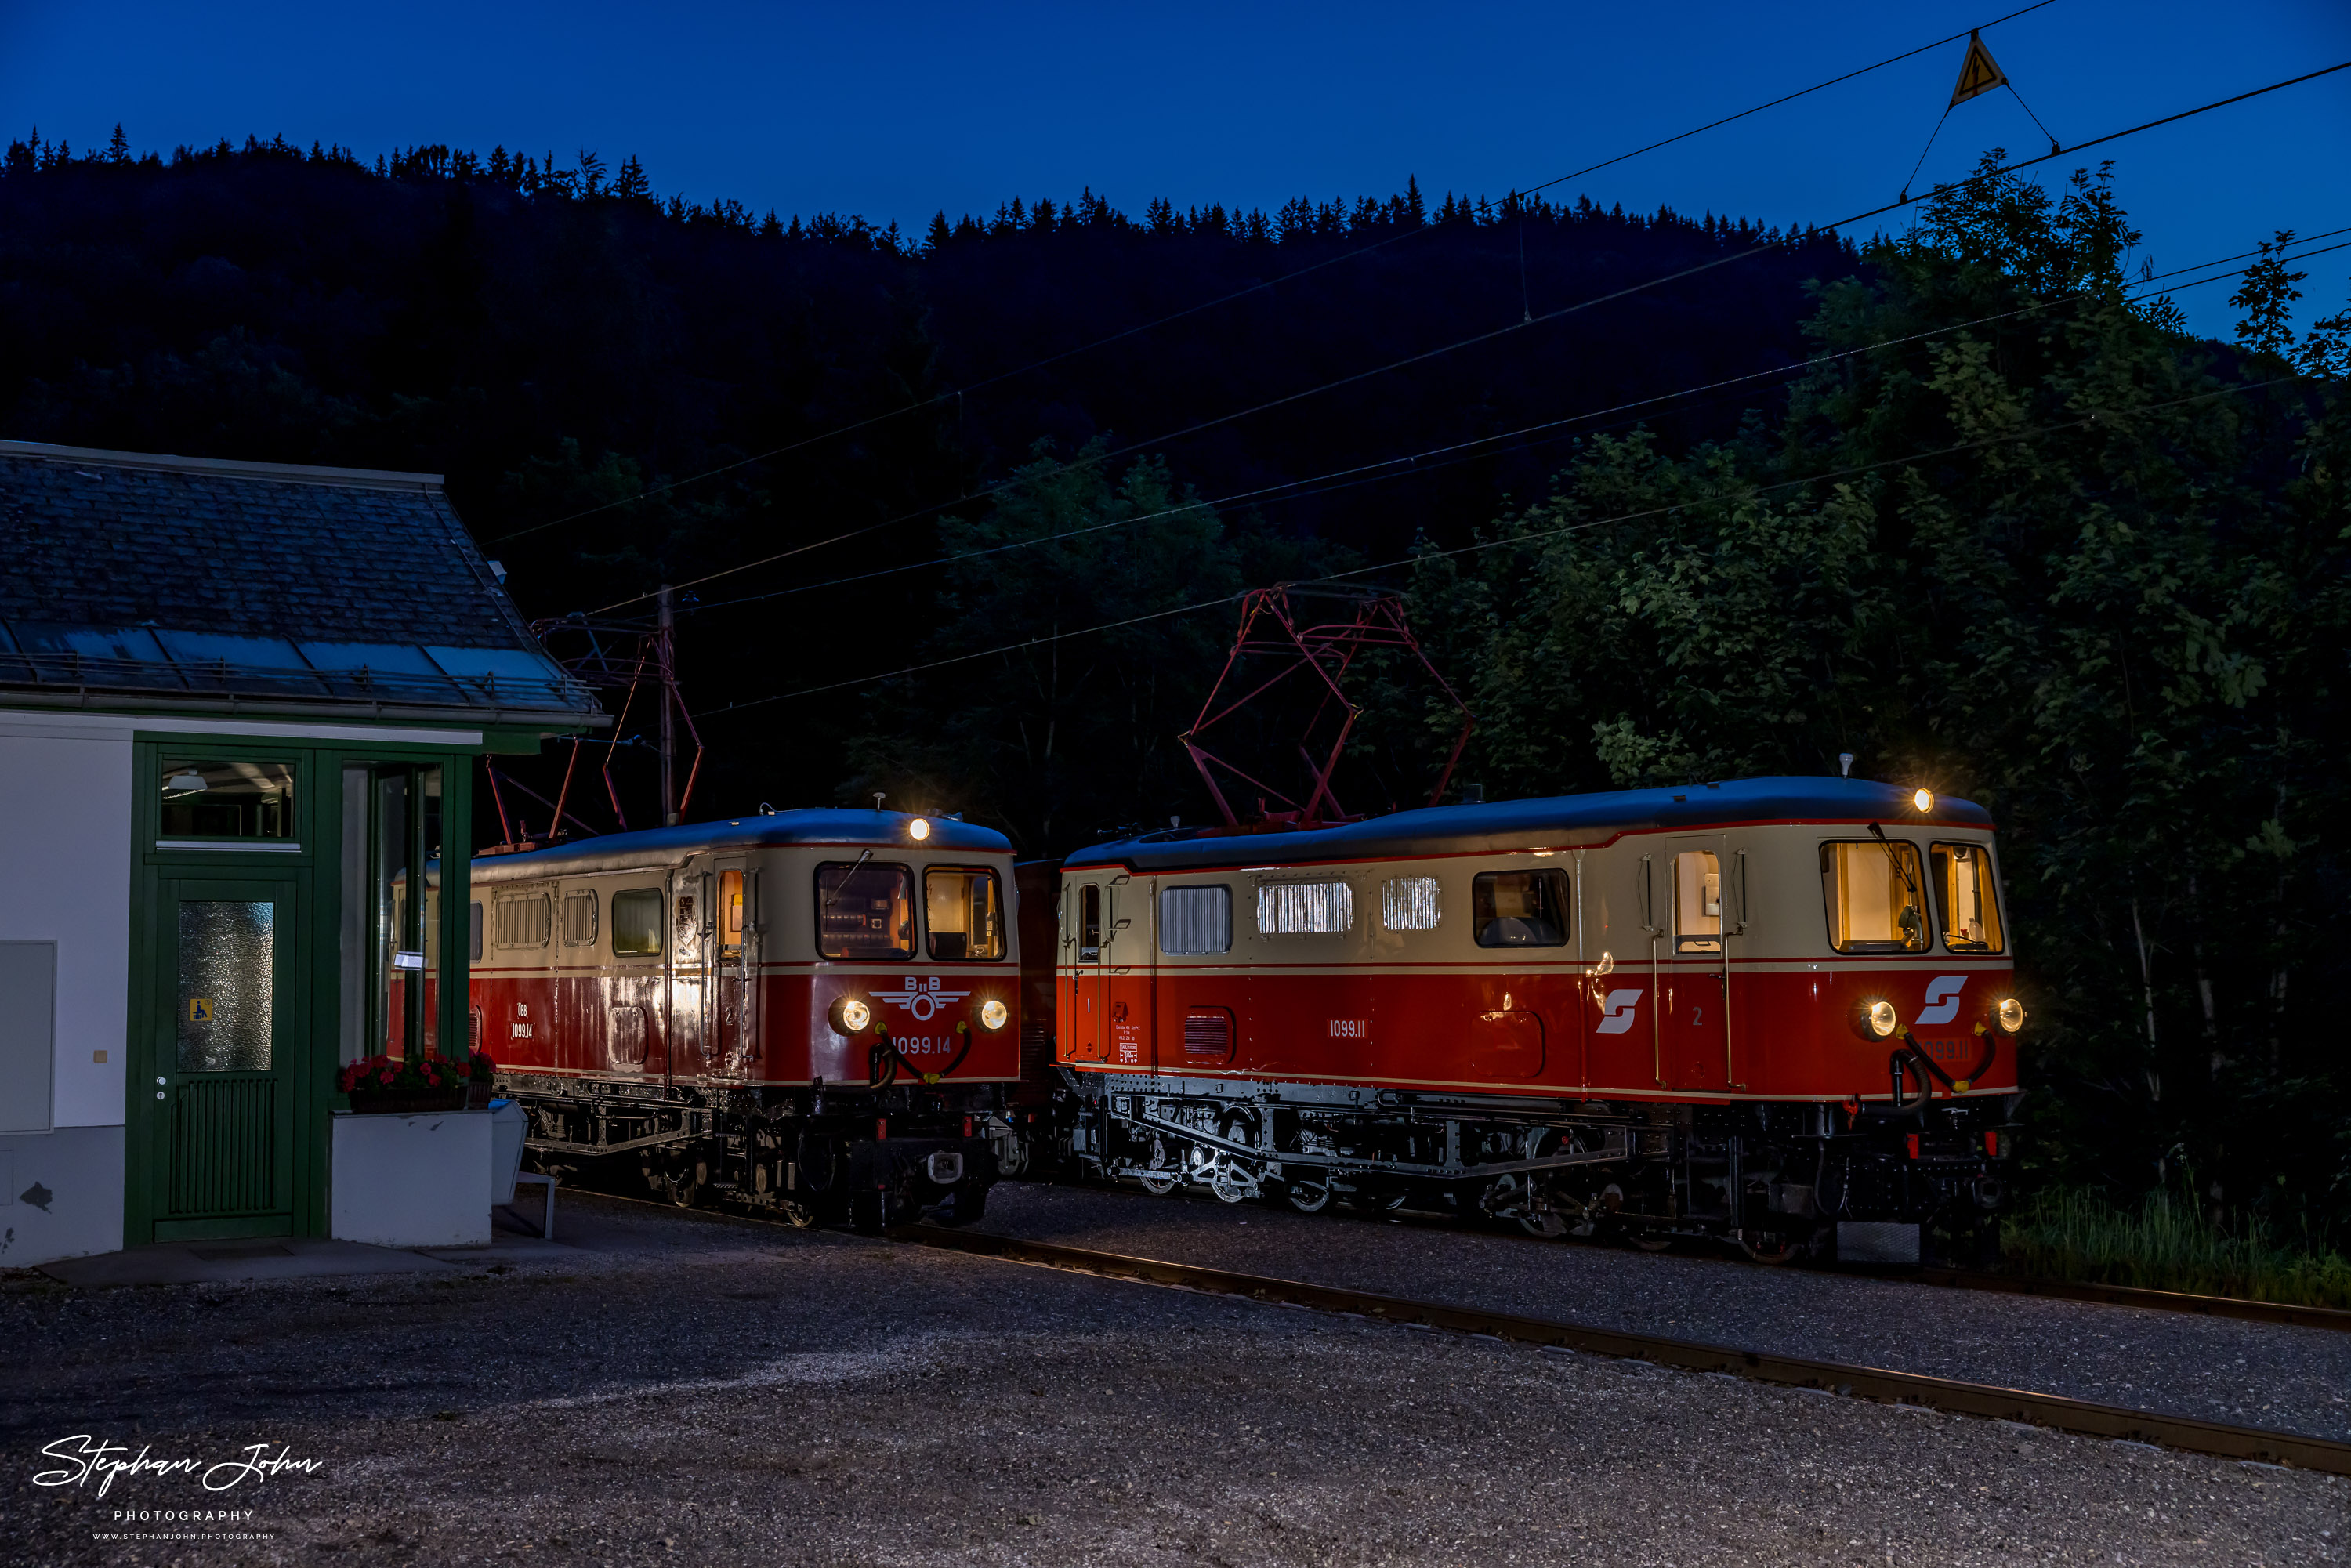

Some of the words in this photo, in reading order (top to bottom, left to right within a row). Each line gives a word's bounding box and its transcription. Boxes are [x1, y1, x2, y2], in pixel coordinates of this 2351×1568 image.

[1692, 1006, 1702, 1026] 2
[512, 1023, 533, 1038] 1099.14
[1330, 1019, 1365, 1037] 1099.11
